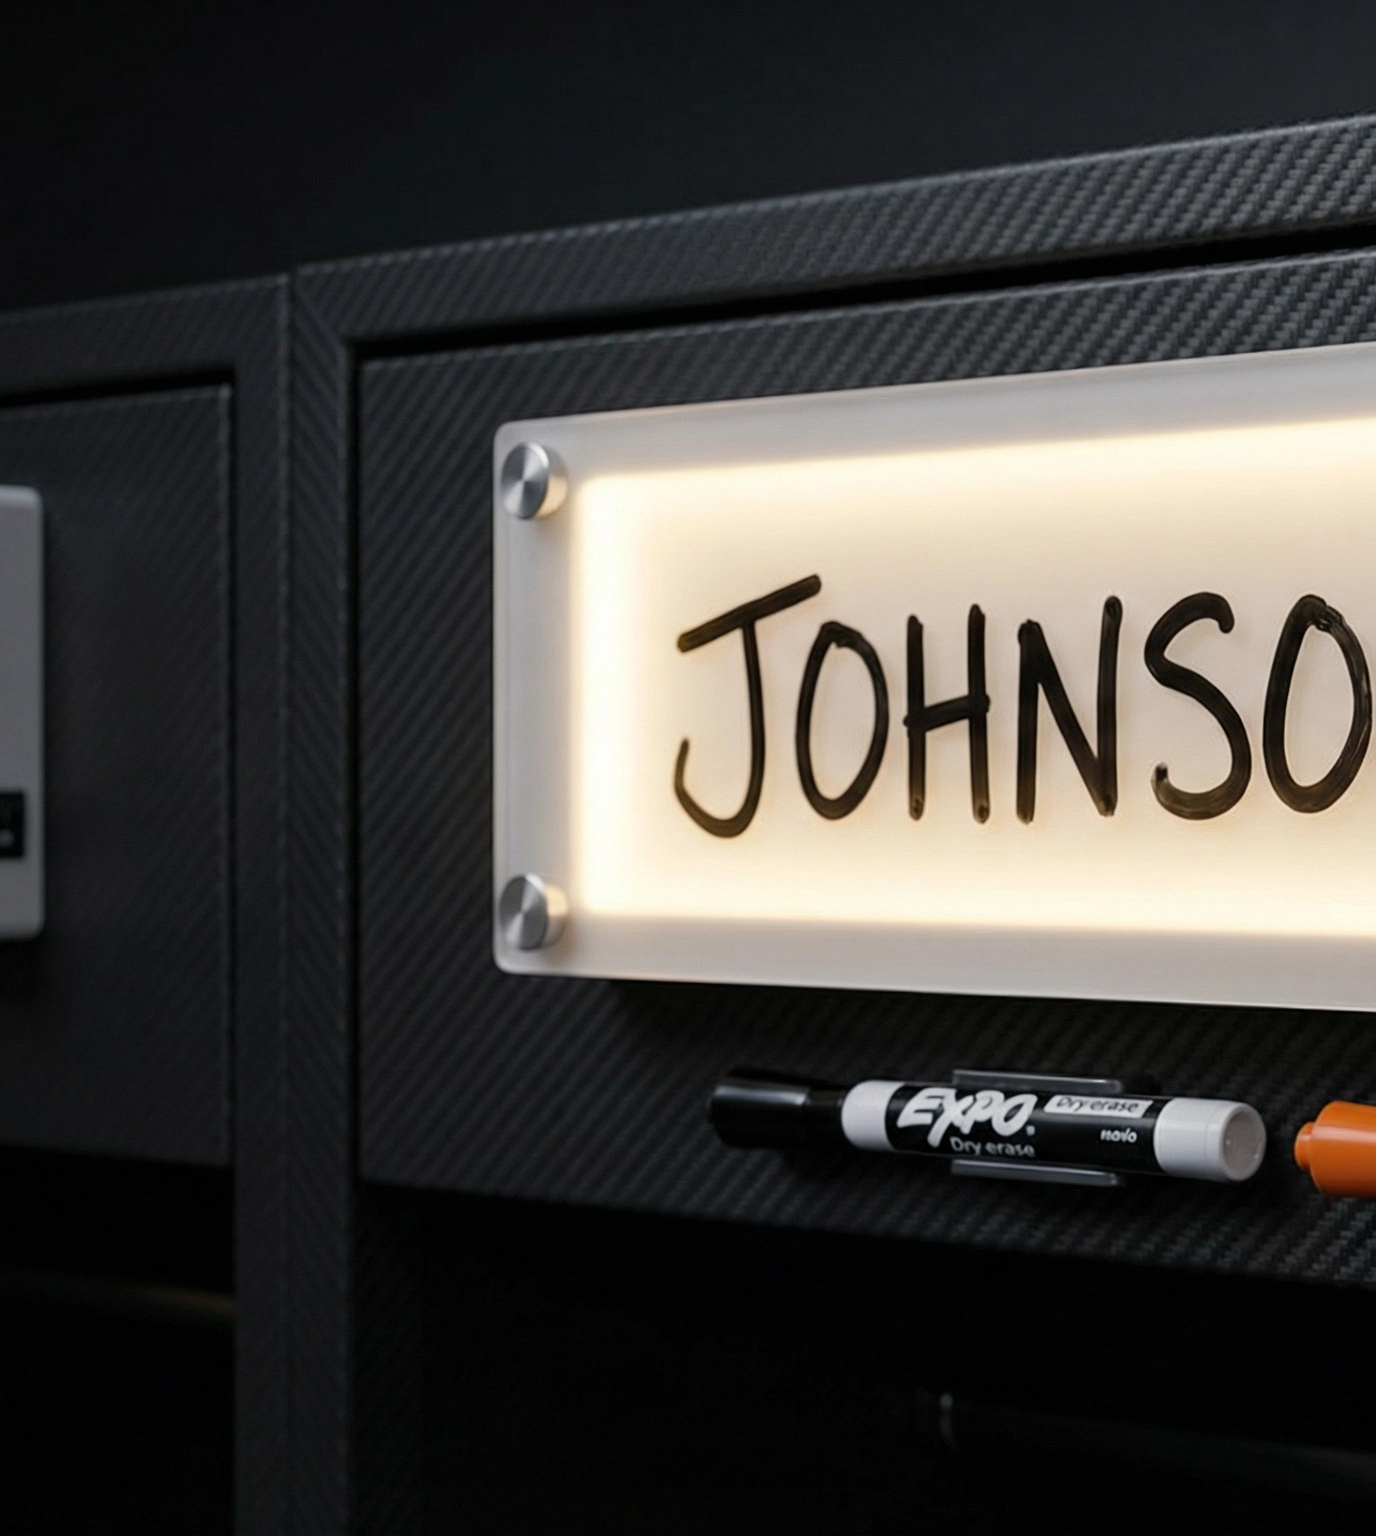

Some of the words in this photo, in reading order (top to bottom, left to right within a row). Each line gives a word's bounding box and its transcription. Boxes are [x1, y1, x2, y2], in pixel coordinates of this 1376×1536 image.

[1056, 1097, 1084, 1112] Dry
[1090, 1101, 1139, 1113] erase
[950, 1136, 981, 1156] Dry
[985, 1142, 1036, 1157] erase
